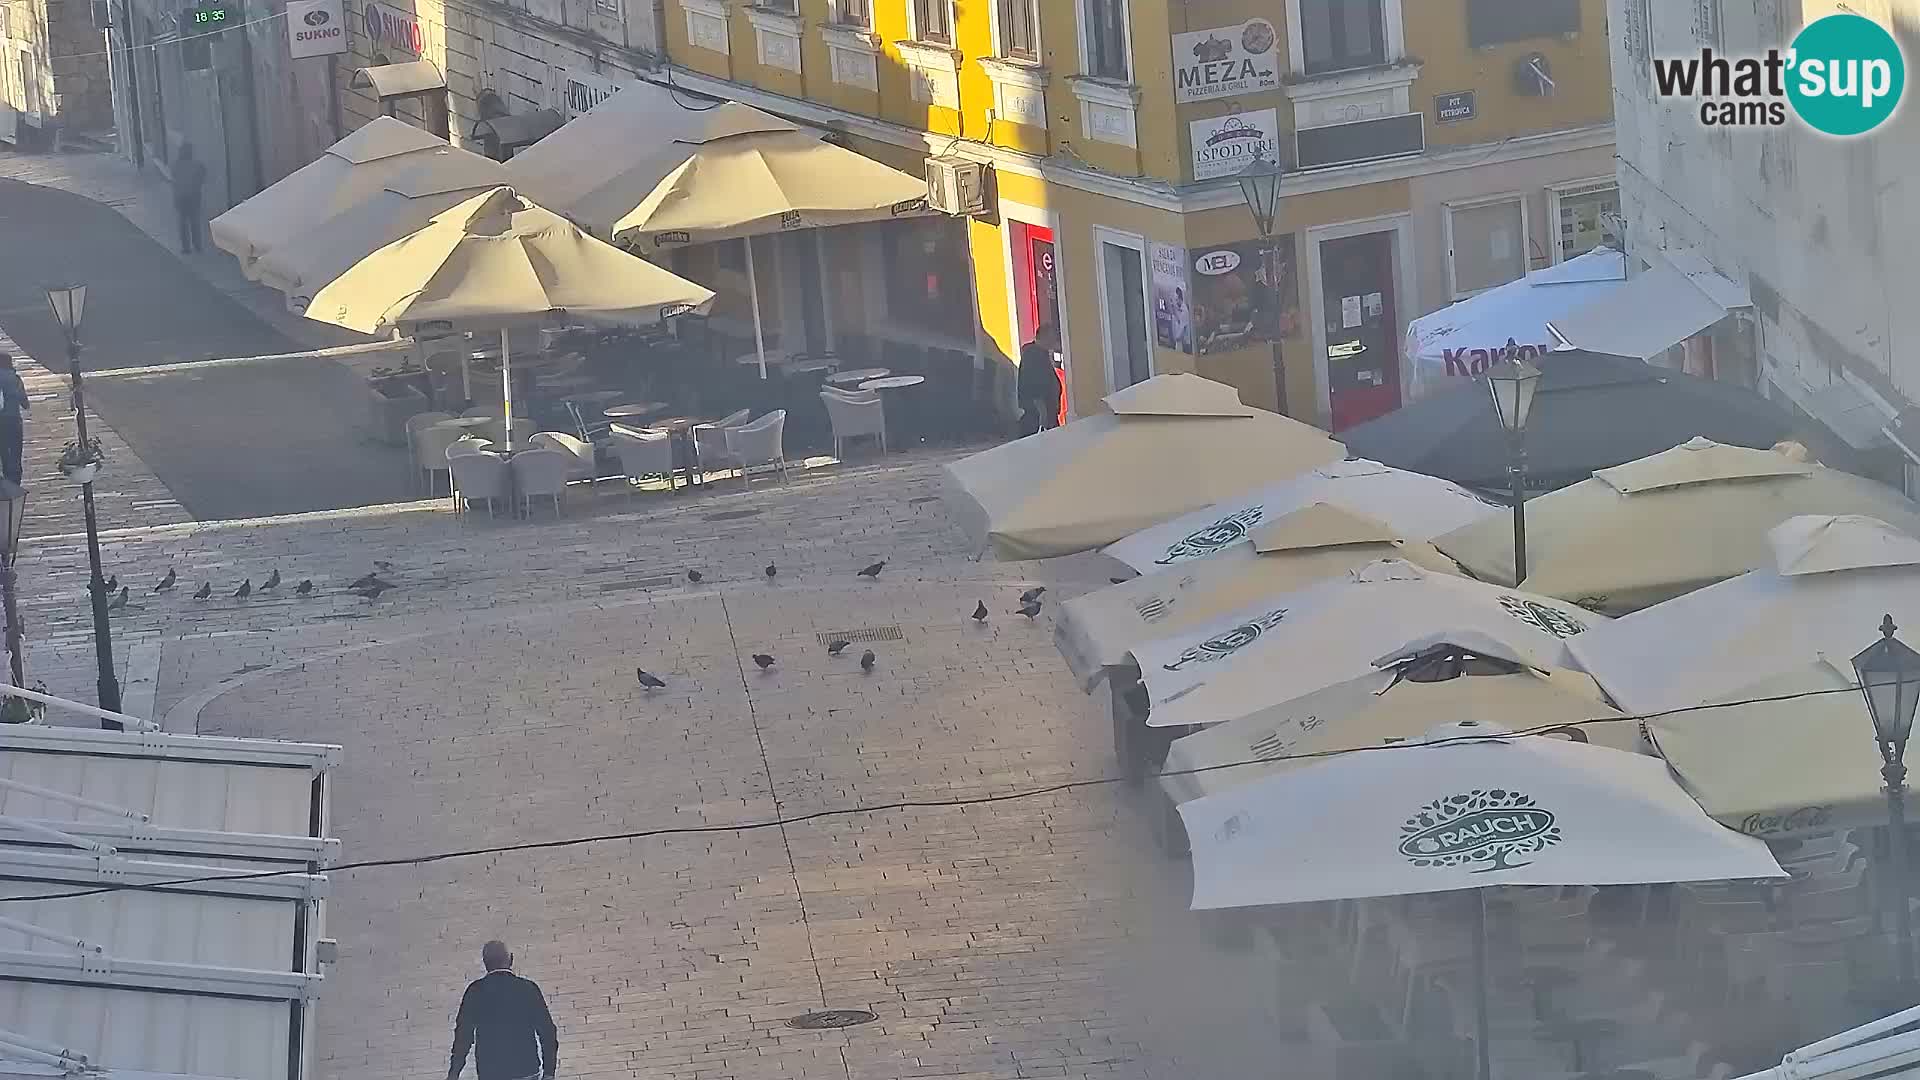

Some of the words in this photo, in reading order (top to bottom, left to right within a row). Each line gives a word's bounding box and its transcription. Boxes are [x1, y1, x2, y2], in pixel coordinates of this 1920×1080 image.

[195, 12, 208, 23] 18
[211, 10, 225, 21] 35
[296, 27, 341, 41] SUKNO
[1178, 58, 1257, 89] MEZA
[1196, 144, 1242, 162] ISPOD
[1438, 814, 1537, 848] RAUCH
